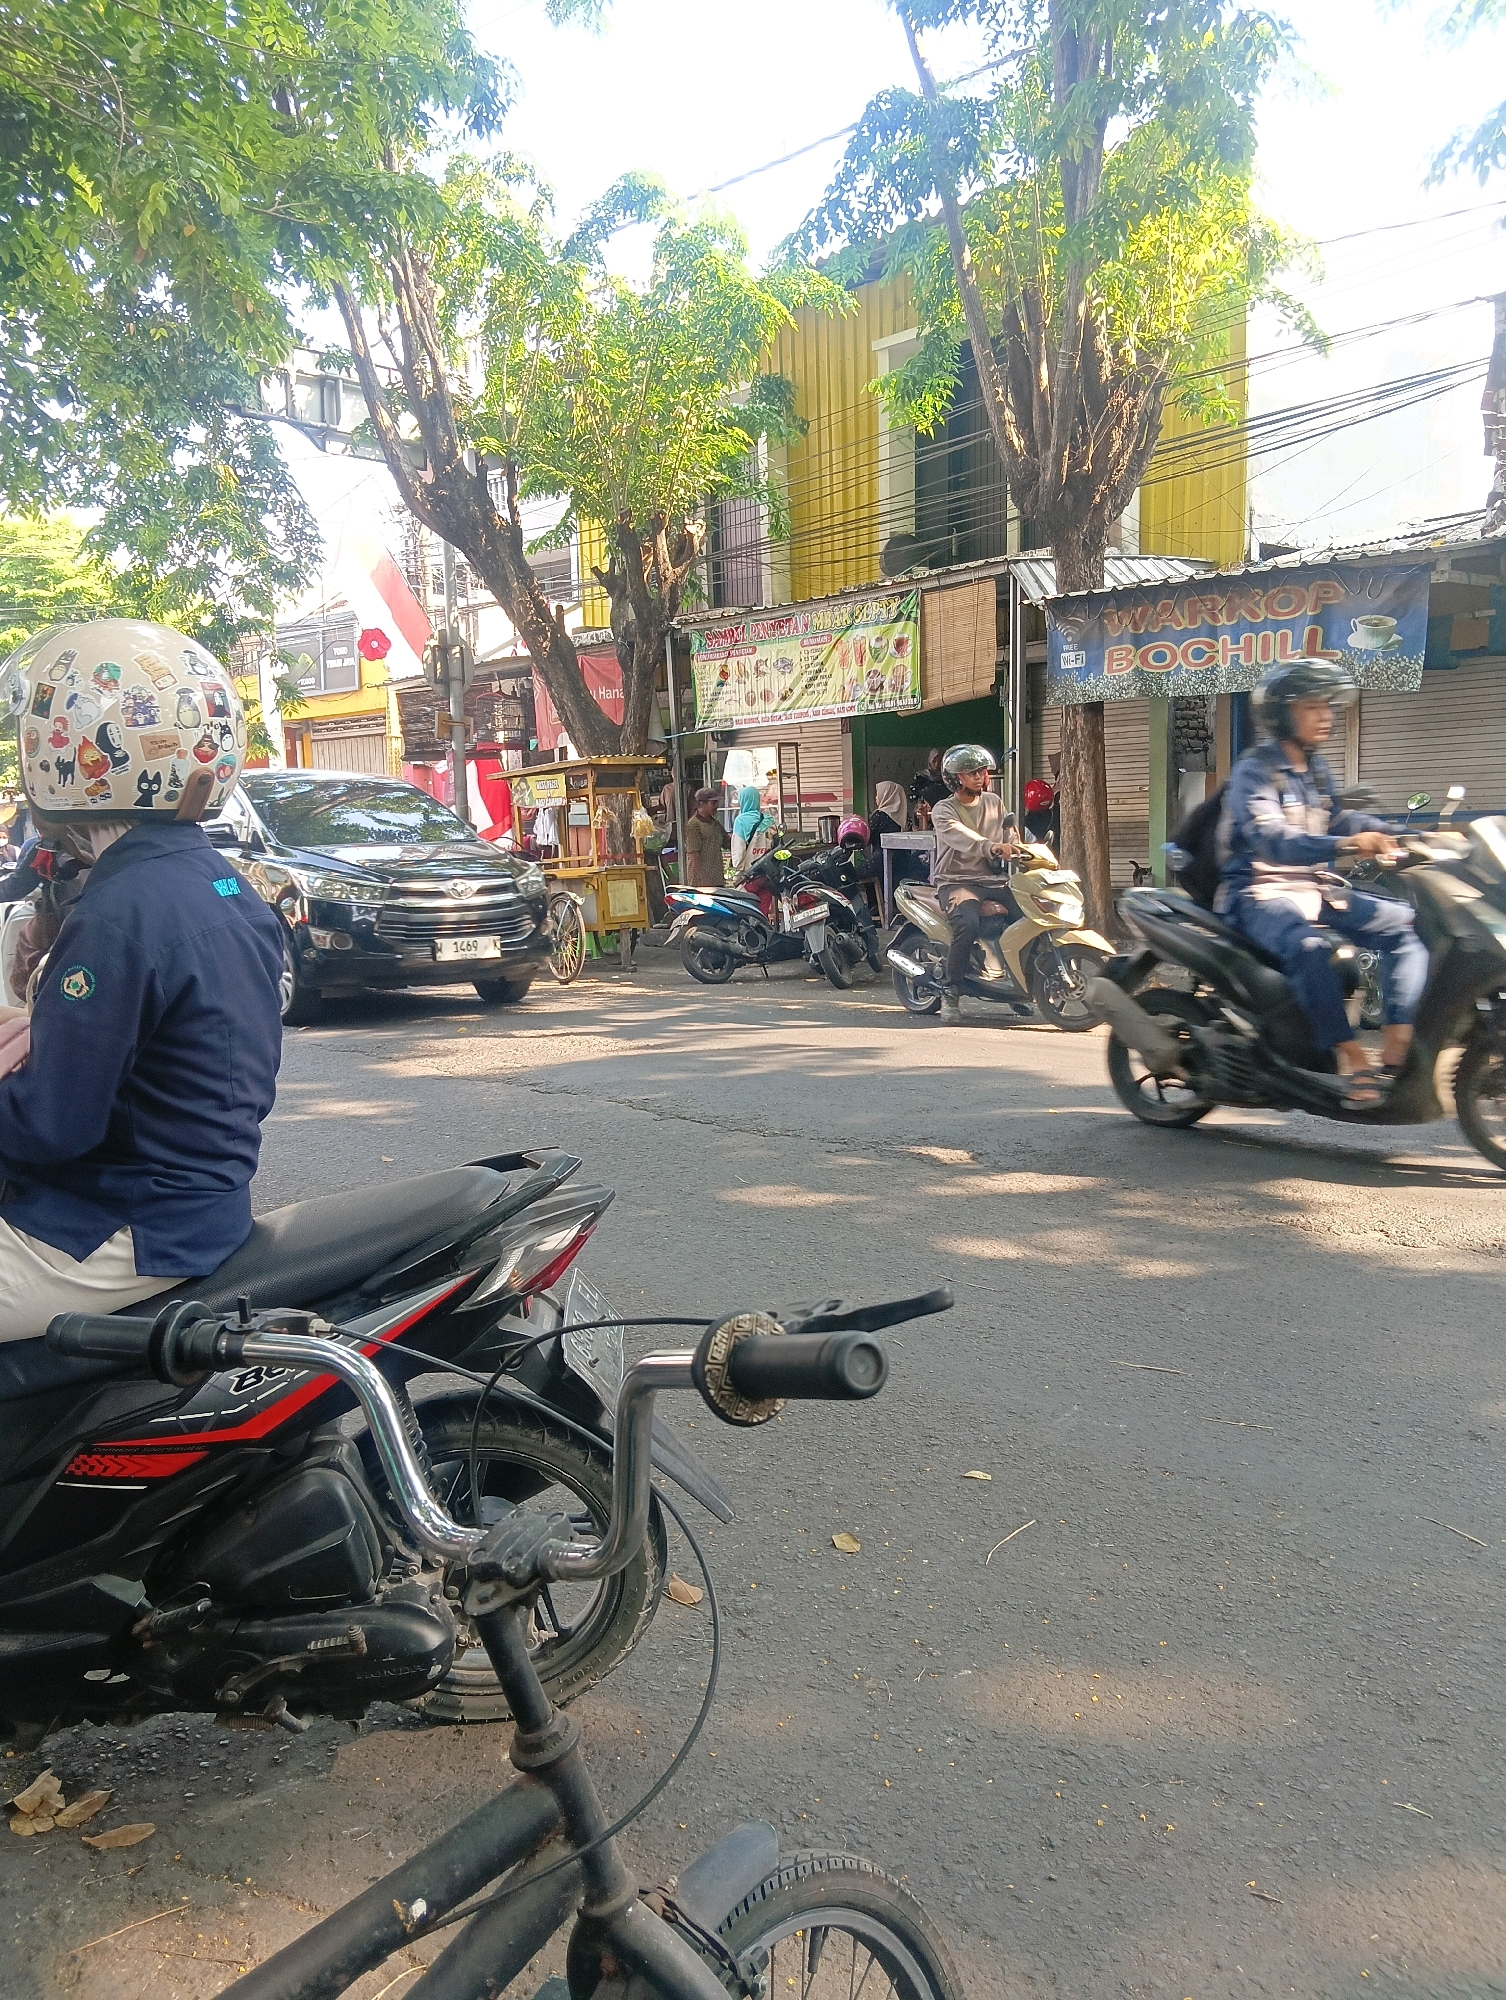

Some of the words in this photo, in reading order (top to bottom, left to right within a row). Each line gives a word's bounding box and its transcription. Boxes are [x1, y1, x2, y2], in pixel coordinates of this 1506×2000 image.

[1104, 581, 1345, 636] WARKOP
[749, 613, 810, 642] PENYETAN
[1062, 654, 1084, 666] Wi-Fi
[1104, 625, 1342, 675] BOCHILL
[453, 940, 478, 952] 1469
